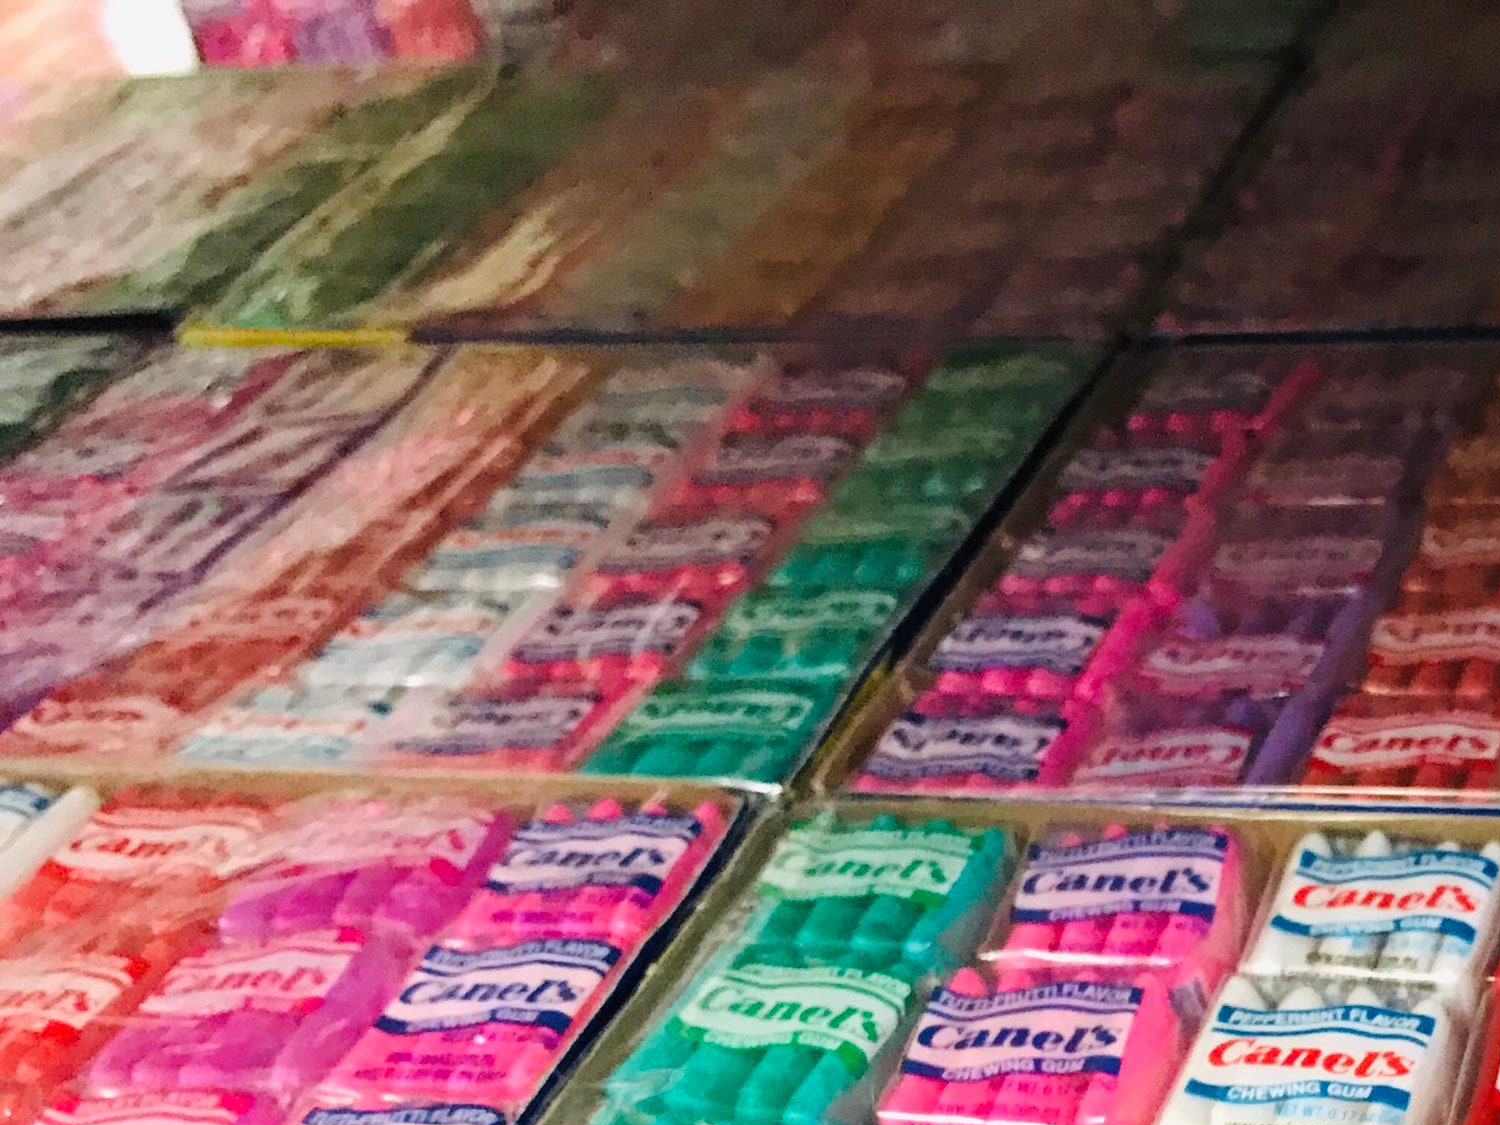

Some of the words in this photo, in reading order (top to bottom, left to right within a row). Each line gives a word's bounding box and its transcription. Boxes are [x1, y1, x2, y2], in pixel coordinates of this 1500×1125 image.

[1023, 868, 1211, 896] Canel's
[1293, 884, 1478, 913] Canel's
[917, 1024, 1123, 1053] Canel's
[941, 1058, 1034, 1083] CHEWING
[1042, 1057, 1085, 1074] GUM
[1207, 1037, 1417, 1080] Canel's
[1227, 1081, 1321, 1102] CHEWING
[1327, 1082, 1373, 1101] GUM
